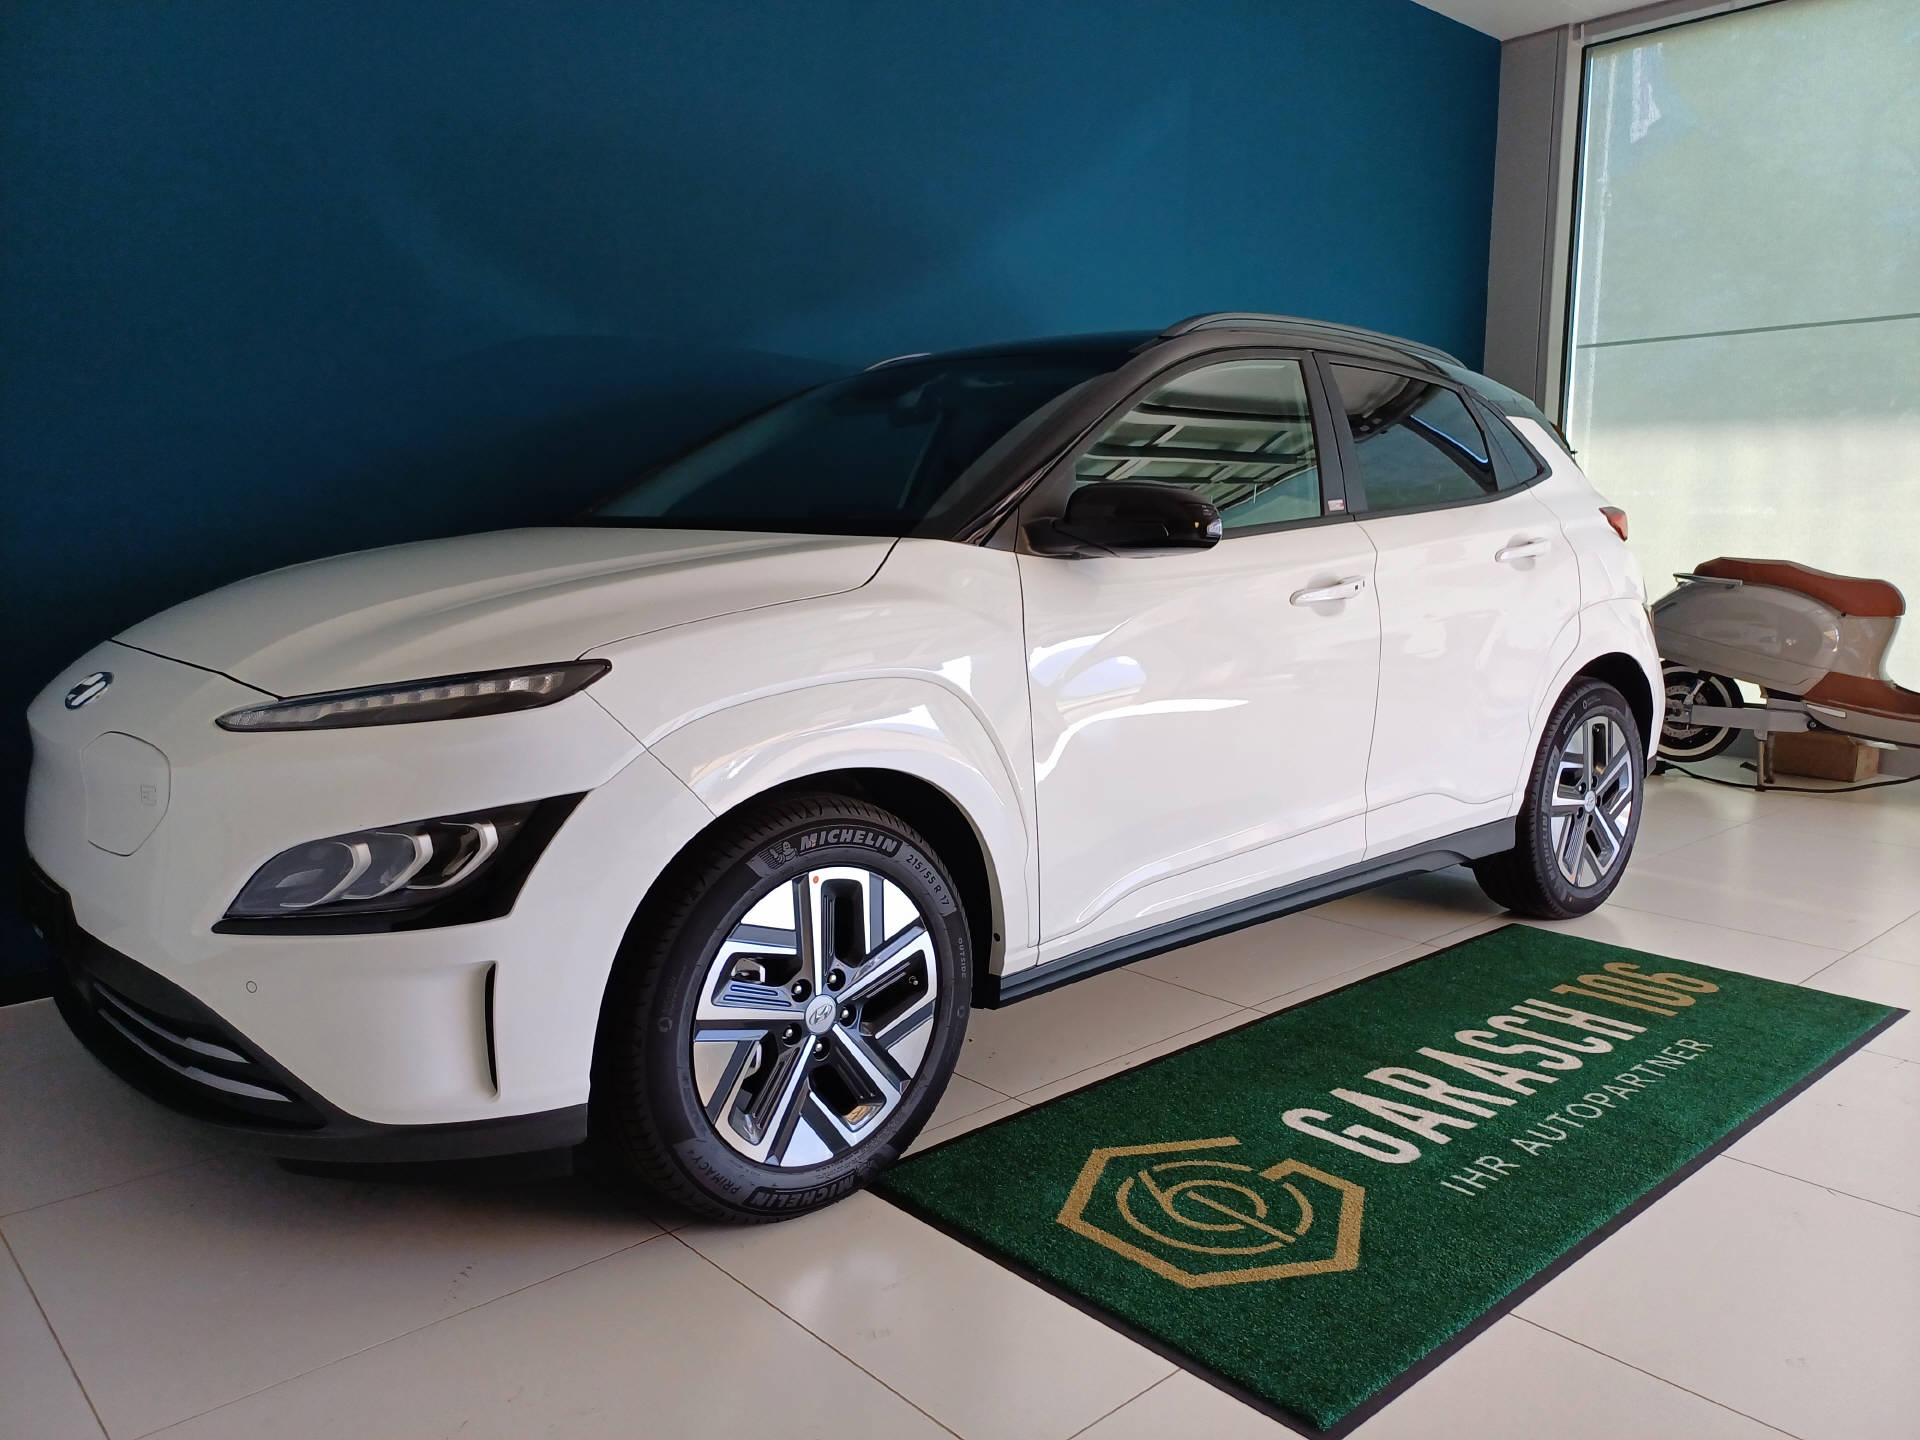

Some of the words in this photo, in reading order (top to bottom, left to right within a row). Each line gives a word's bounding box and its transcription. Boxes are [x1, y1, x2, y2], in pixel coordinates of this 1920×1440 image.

[801, 829, 898, 852] MICHELIN
[905, 854, 935, 885] 215/55
[933, 885, 942, 894] R
[941, 895, 950, 906] 17
[958, 937, 967, 979] OUTSIDE
[1281, 997, 1648, 1164] GARASCH
[1551, 961, 1720, 1017] 106
[1440, 1155, 1520, 1196] IHR
[1510, 1037, 1714, 1156] AUTOPARTNER
[693, 1155, 740, 1194] PRIMACY
[751, 1173, 856, 1207] MICHELIN
